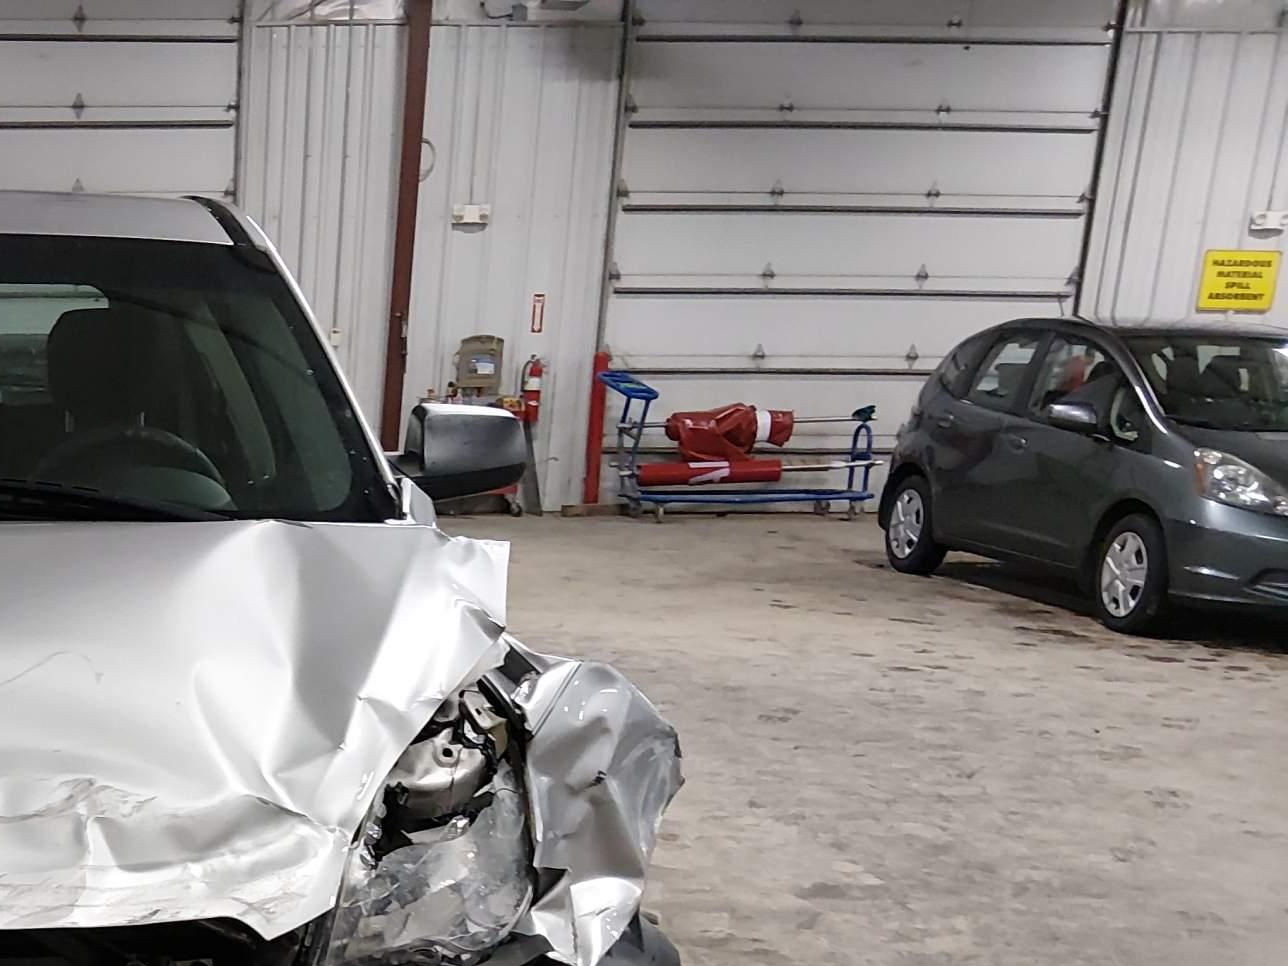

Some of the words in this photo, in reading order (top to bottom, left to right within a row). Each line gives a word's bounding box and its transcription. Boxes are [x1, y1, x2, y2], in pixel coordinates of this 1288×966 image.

[1212, 259, 1272, 267] HAZARDOUS
[1216, 270, 1263, 278] MATERIAL
[1224, 281, 1251, 289] SPILL
[1207, 292, 1265, 300] ABSORBENT
